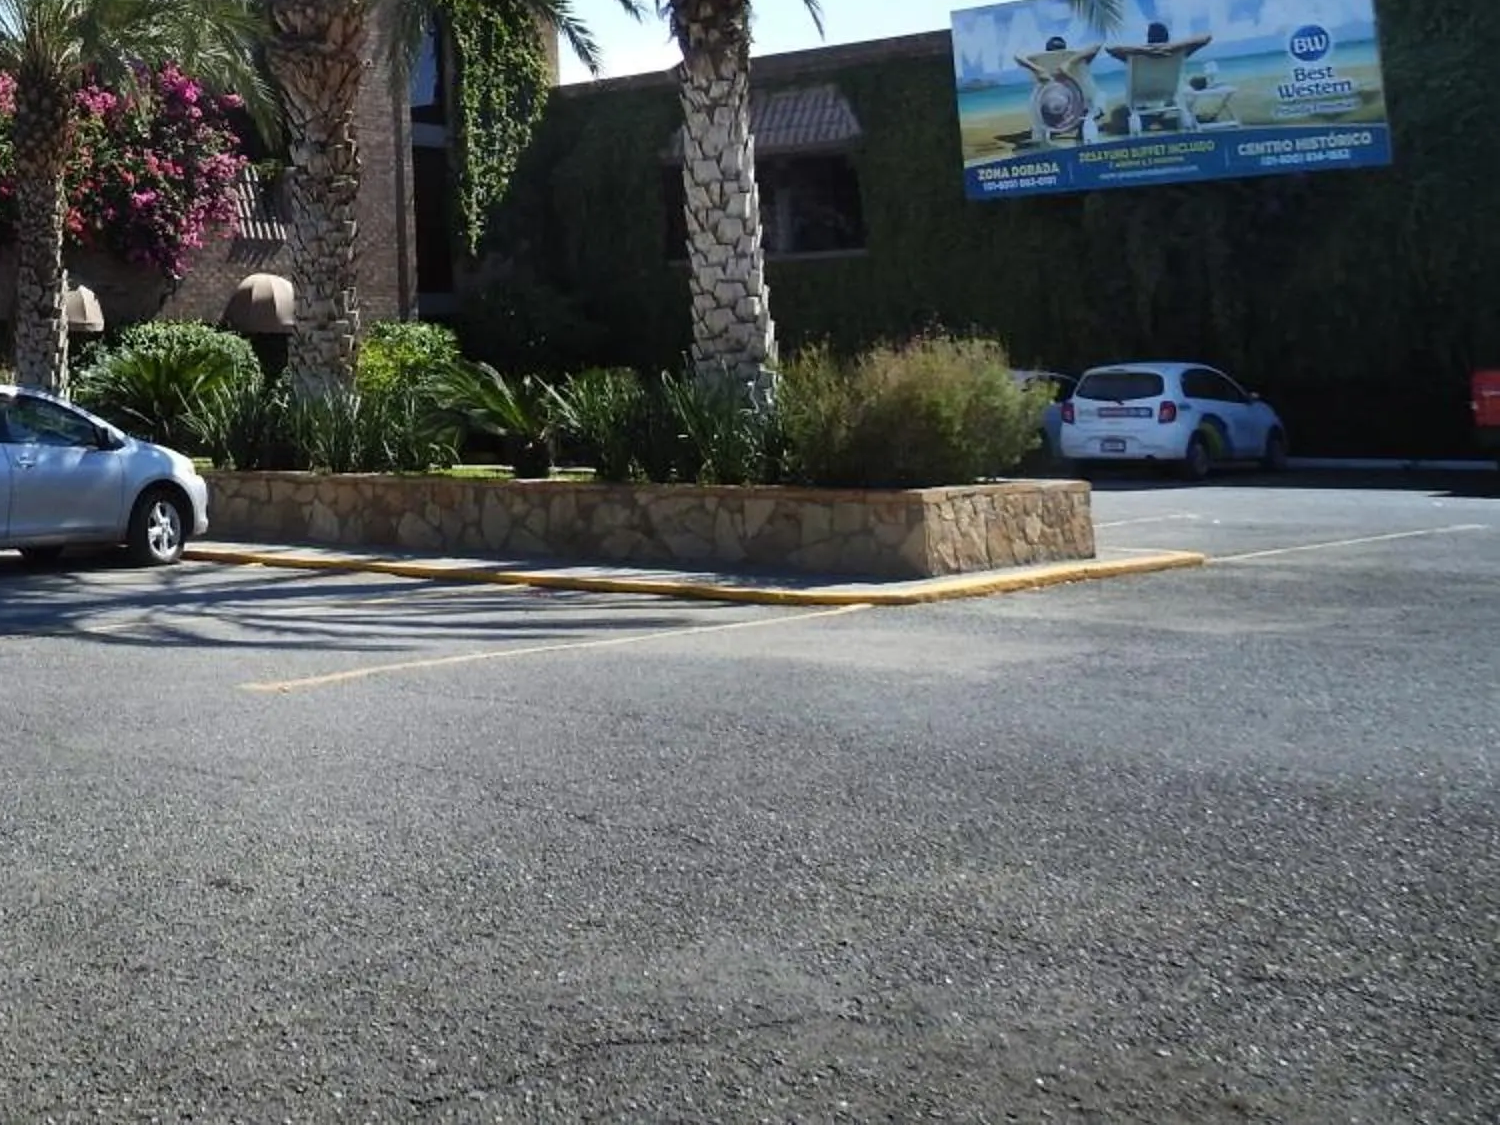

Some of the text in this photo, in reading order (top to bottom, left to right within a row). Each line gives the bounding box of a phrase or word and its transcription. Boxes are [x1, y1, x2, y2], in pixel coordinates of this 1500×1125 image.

[1293, 34, 1327, 54] BW
[1294, 66, 1334, 82] Best
[1278, 81, 1351, 99] Western
[977, 166, 1010, 181] ZONA
